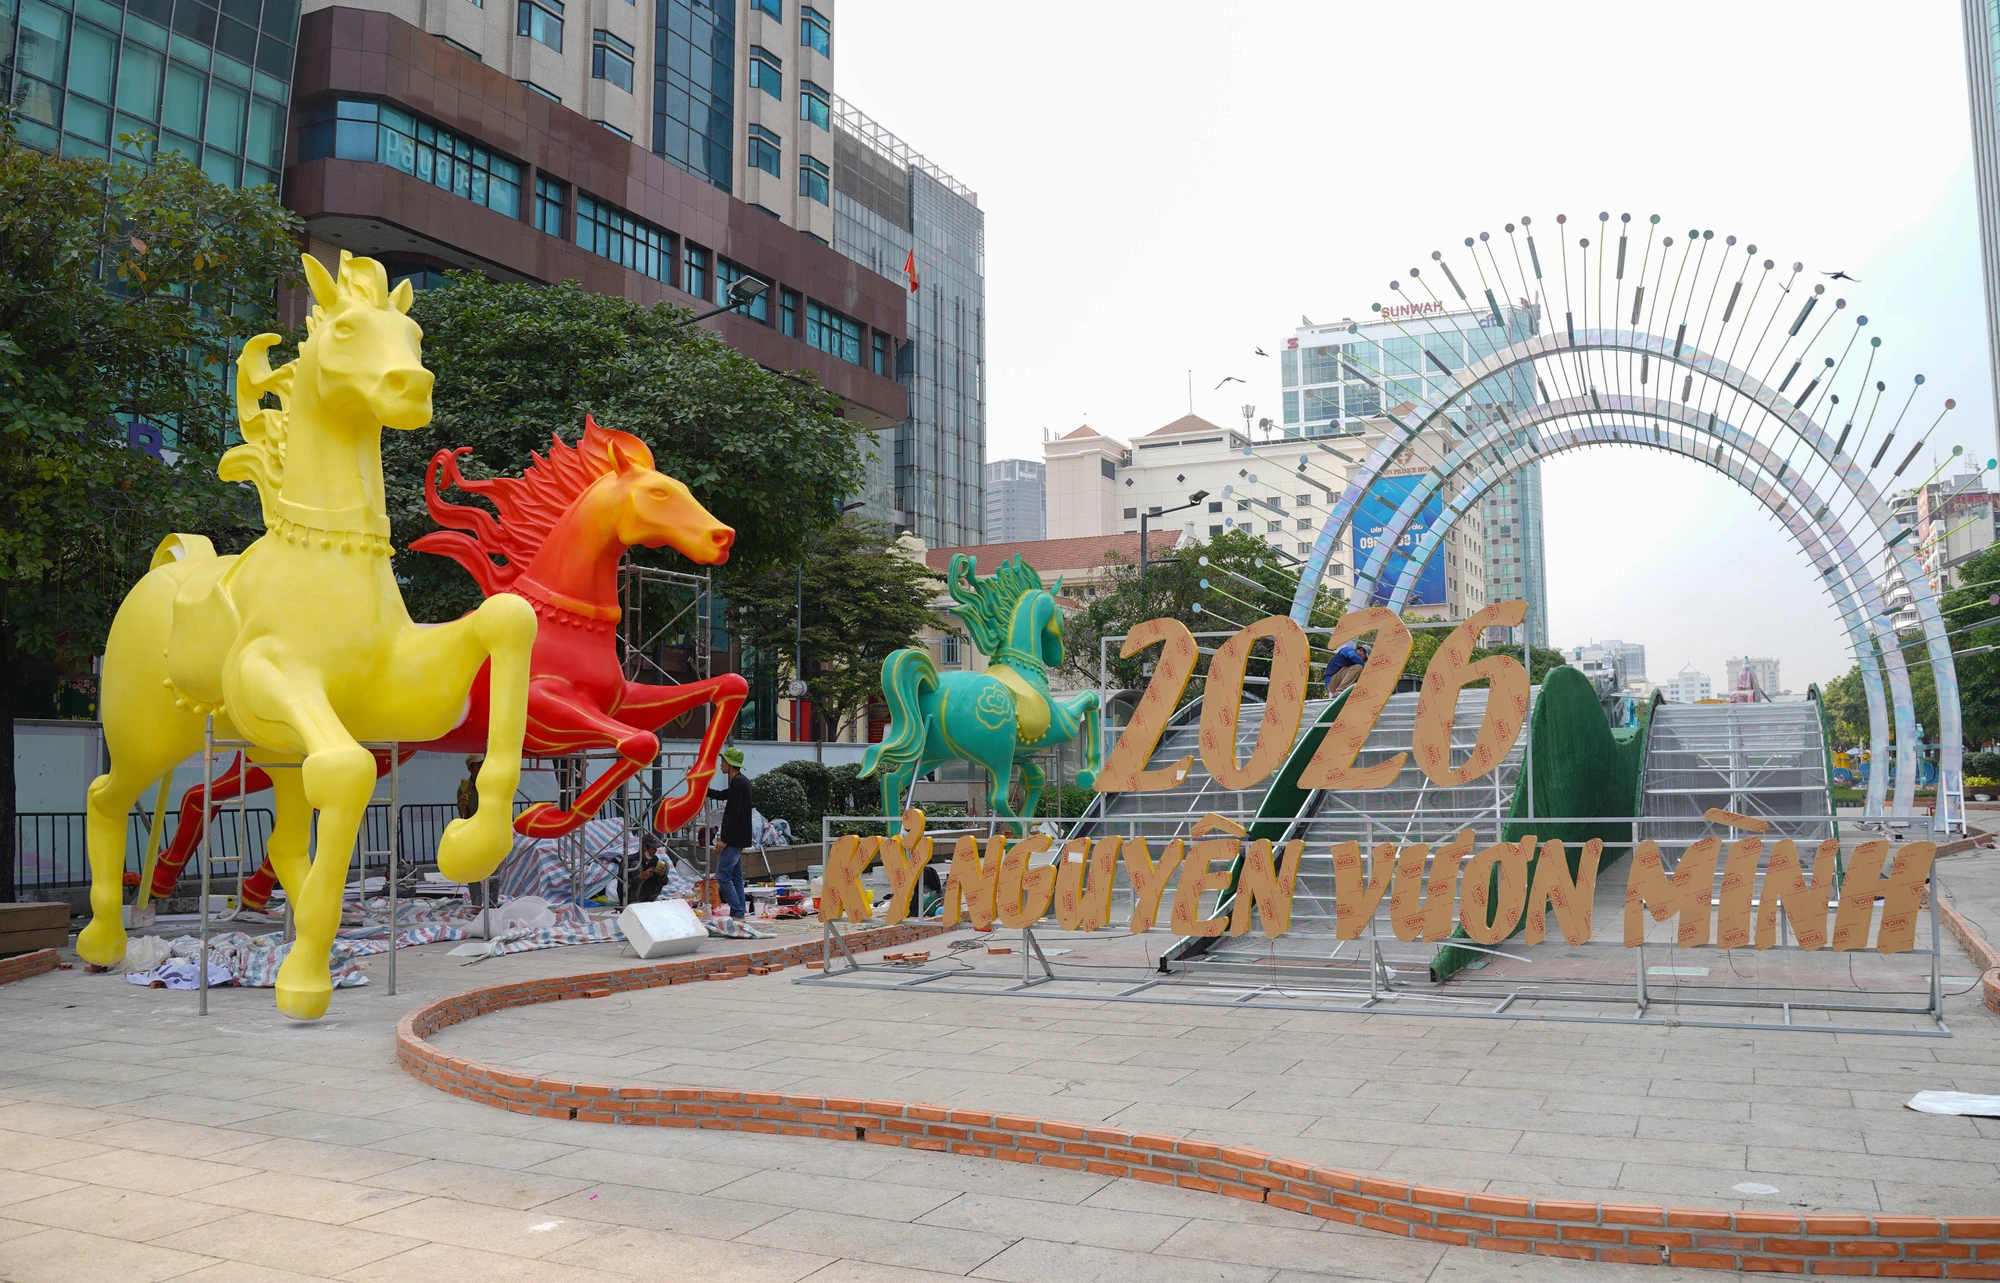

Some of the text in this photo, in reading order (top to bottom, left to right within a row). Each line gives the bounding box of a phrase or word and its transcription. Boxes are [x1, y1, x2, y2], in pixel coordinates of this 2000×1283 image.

[1381, 301, 1443, 319] SUNWAH
[1371, 608, 1389, 618] MICA
[1179, 637, 1188, 655] MICA
[1372, 658, 1390, 668] MICA
[1450, 649, 1458, 667] MICA
[1164, 661, 1172, 678] MICA
[1432, 674, 1440, 692] MICA
[1093, 600, 1529, 792] 2026
[1149, 684, 1157, 701] MICA
[1516, 696, 1524, 714] MICA
[1222, 708, 1230, 725] MICA
[1269, 707, 1278, 724] MICA
[1497, 721, 1506, 739] MICA
[1205, 731, 1214, 748] MICA
[1428, 746, 1436, 765] MICA
[1327, 772, 1345, 781] MICA
[1253, 852, 1261, 871] MICA
[1336, 858, 1355, 866] MICA
[1641, 854, 1659, 864] MICA
[1768, 859, 1787, 868] MICA
[1403, 864, 1421, 874] MICA
[1671, 872, 1690, 882] MICA
[818, 807, 1937, 954] KỶ NGUYÊN VƯƠN MÌNH
[1428, 883, 1447, 892] MICA
[1722, 877, 1740, 886] MICA
[1476, 886, 1485, 905] MICA
[1554, 887, 1563, 906] MICA
[1406, 916, 1424, 925] MICA
[1535, 912, 1544, 932] MICA
[1883, 918, 1906, 927] MICA
[1724, 932, 1745, 941] MICA
[1799, 935, 1820, 944] MICA
